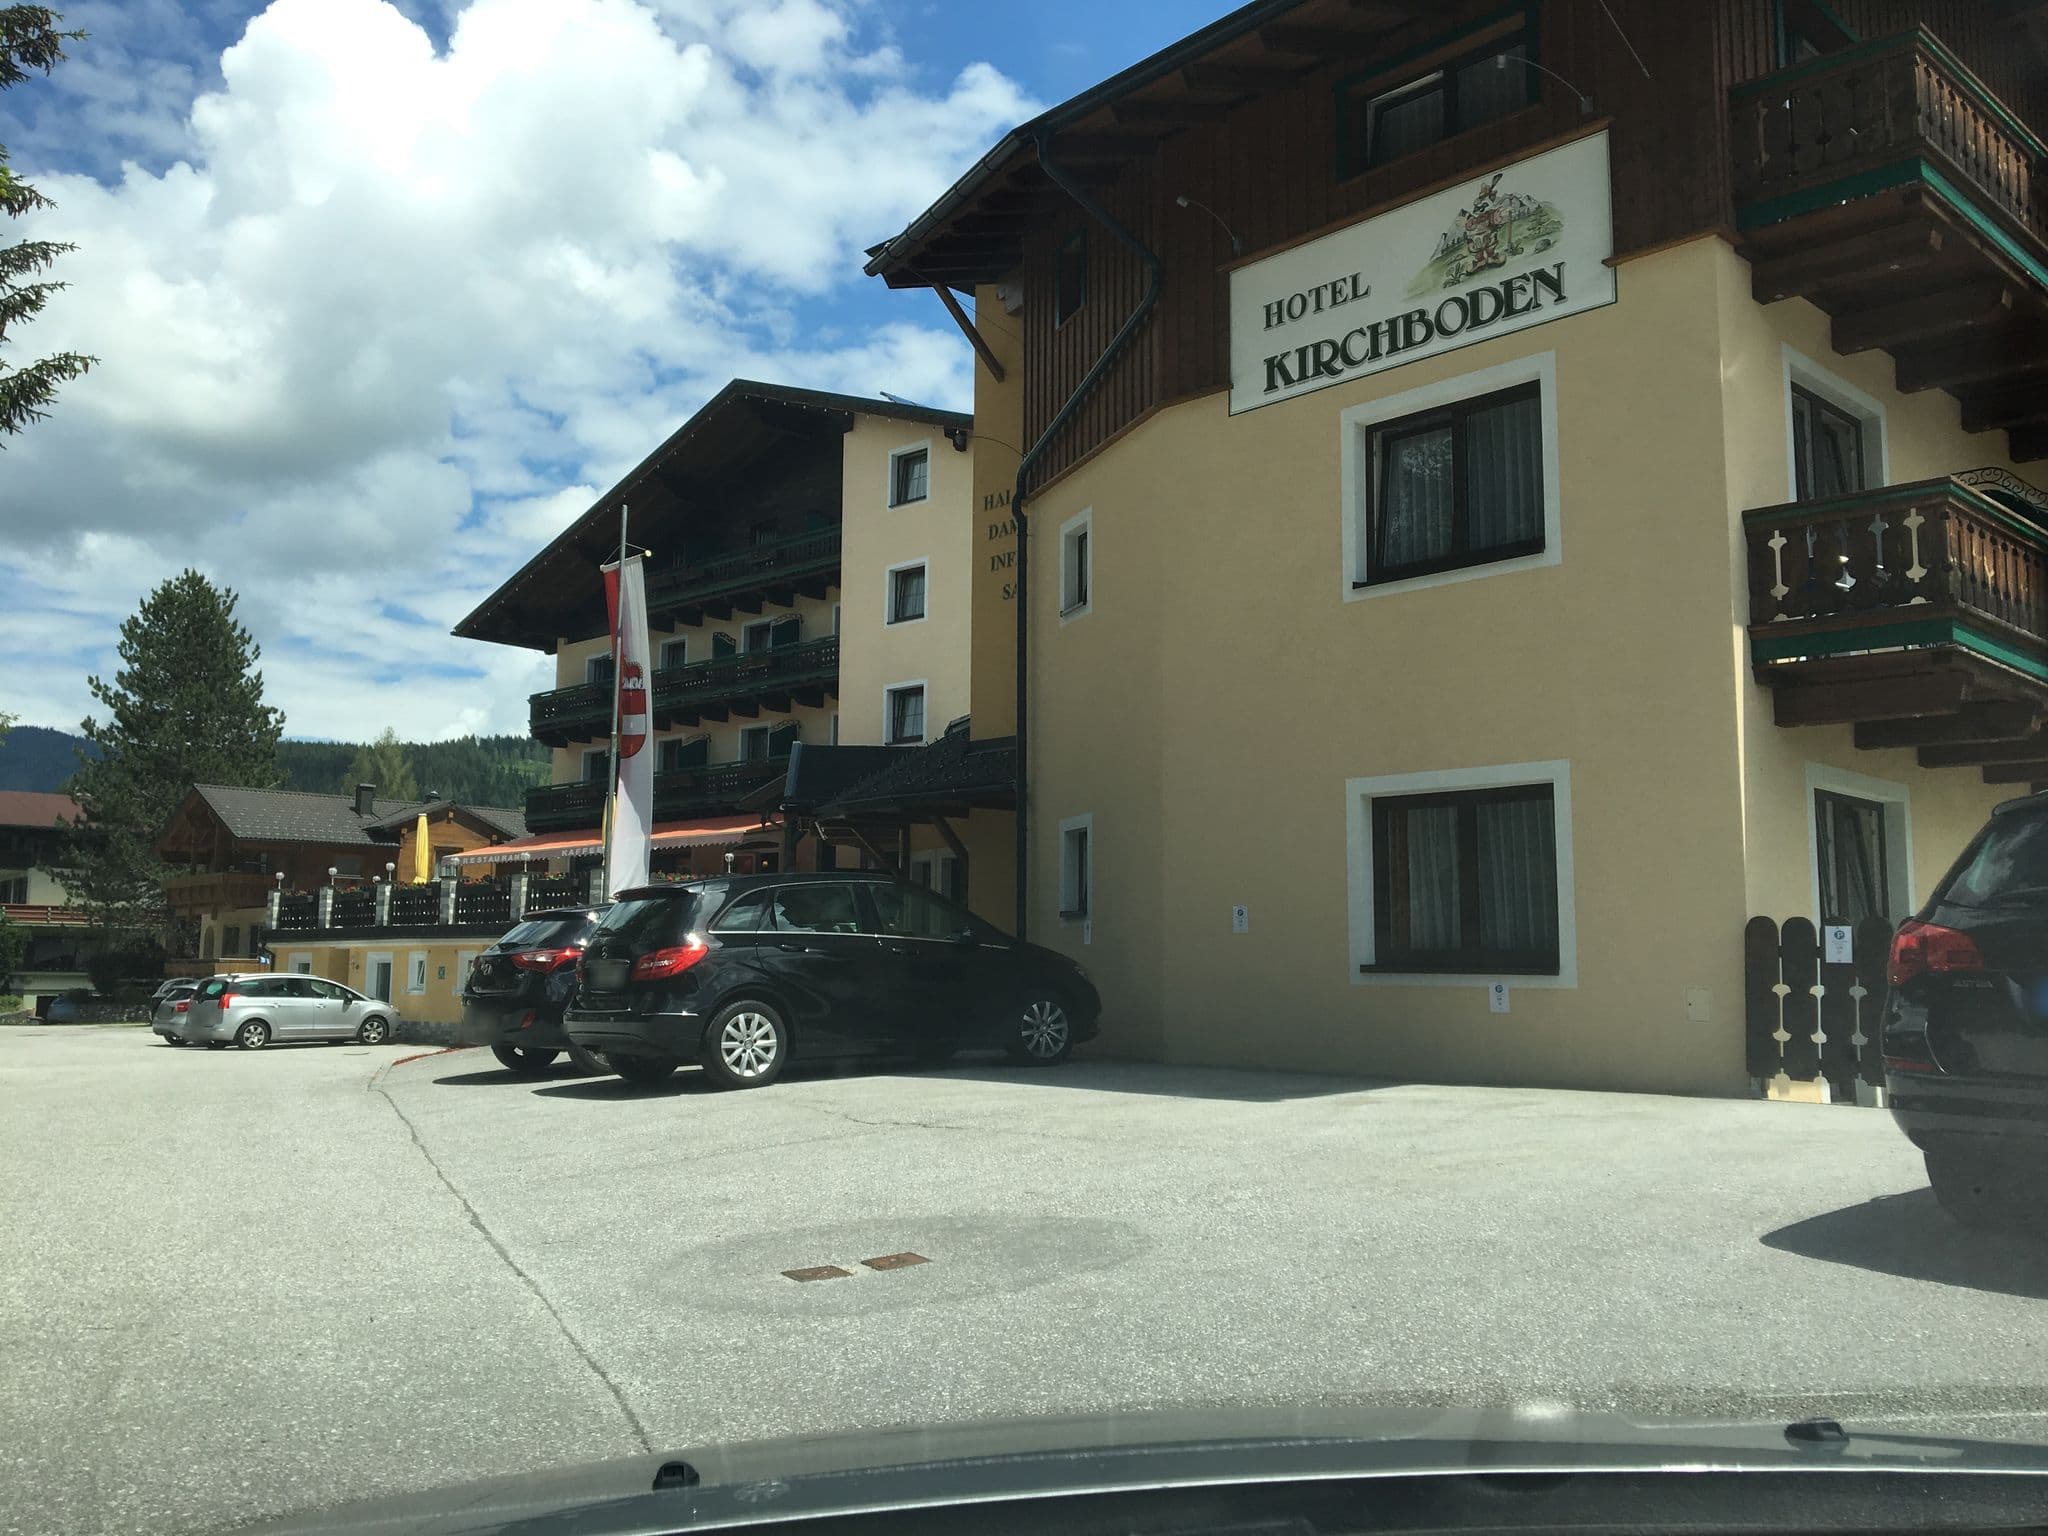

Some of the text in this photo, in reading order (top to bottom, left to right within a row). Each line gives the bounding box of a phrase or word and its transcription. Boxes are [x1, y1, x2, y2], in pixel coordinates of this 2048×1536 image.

[1263, 272, 1370, 329] HOTEL
[1263, 262, 1567, 393] KIRCHBODEN
[462, 854, 530, 865] RESTAURAN
